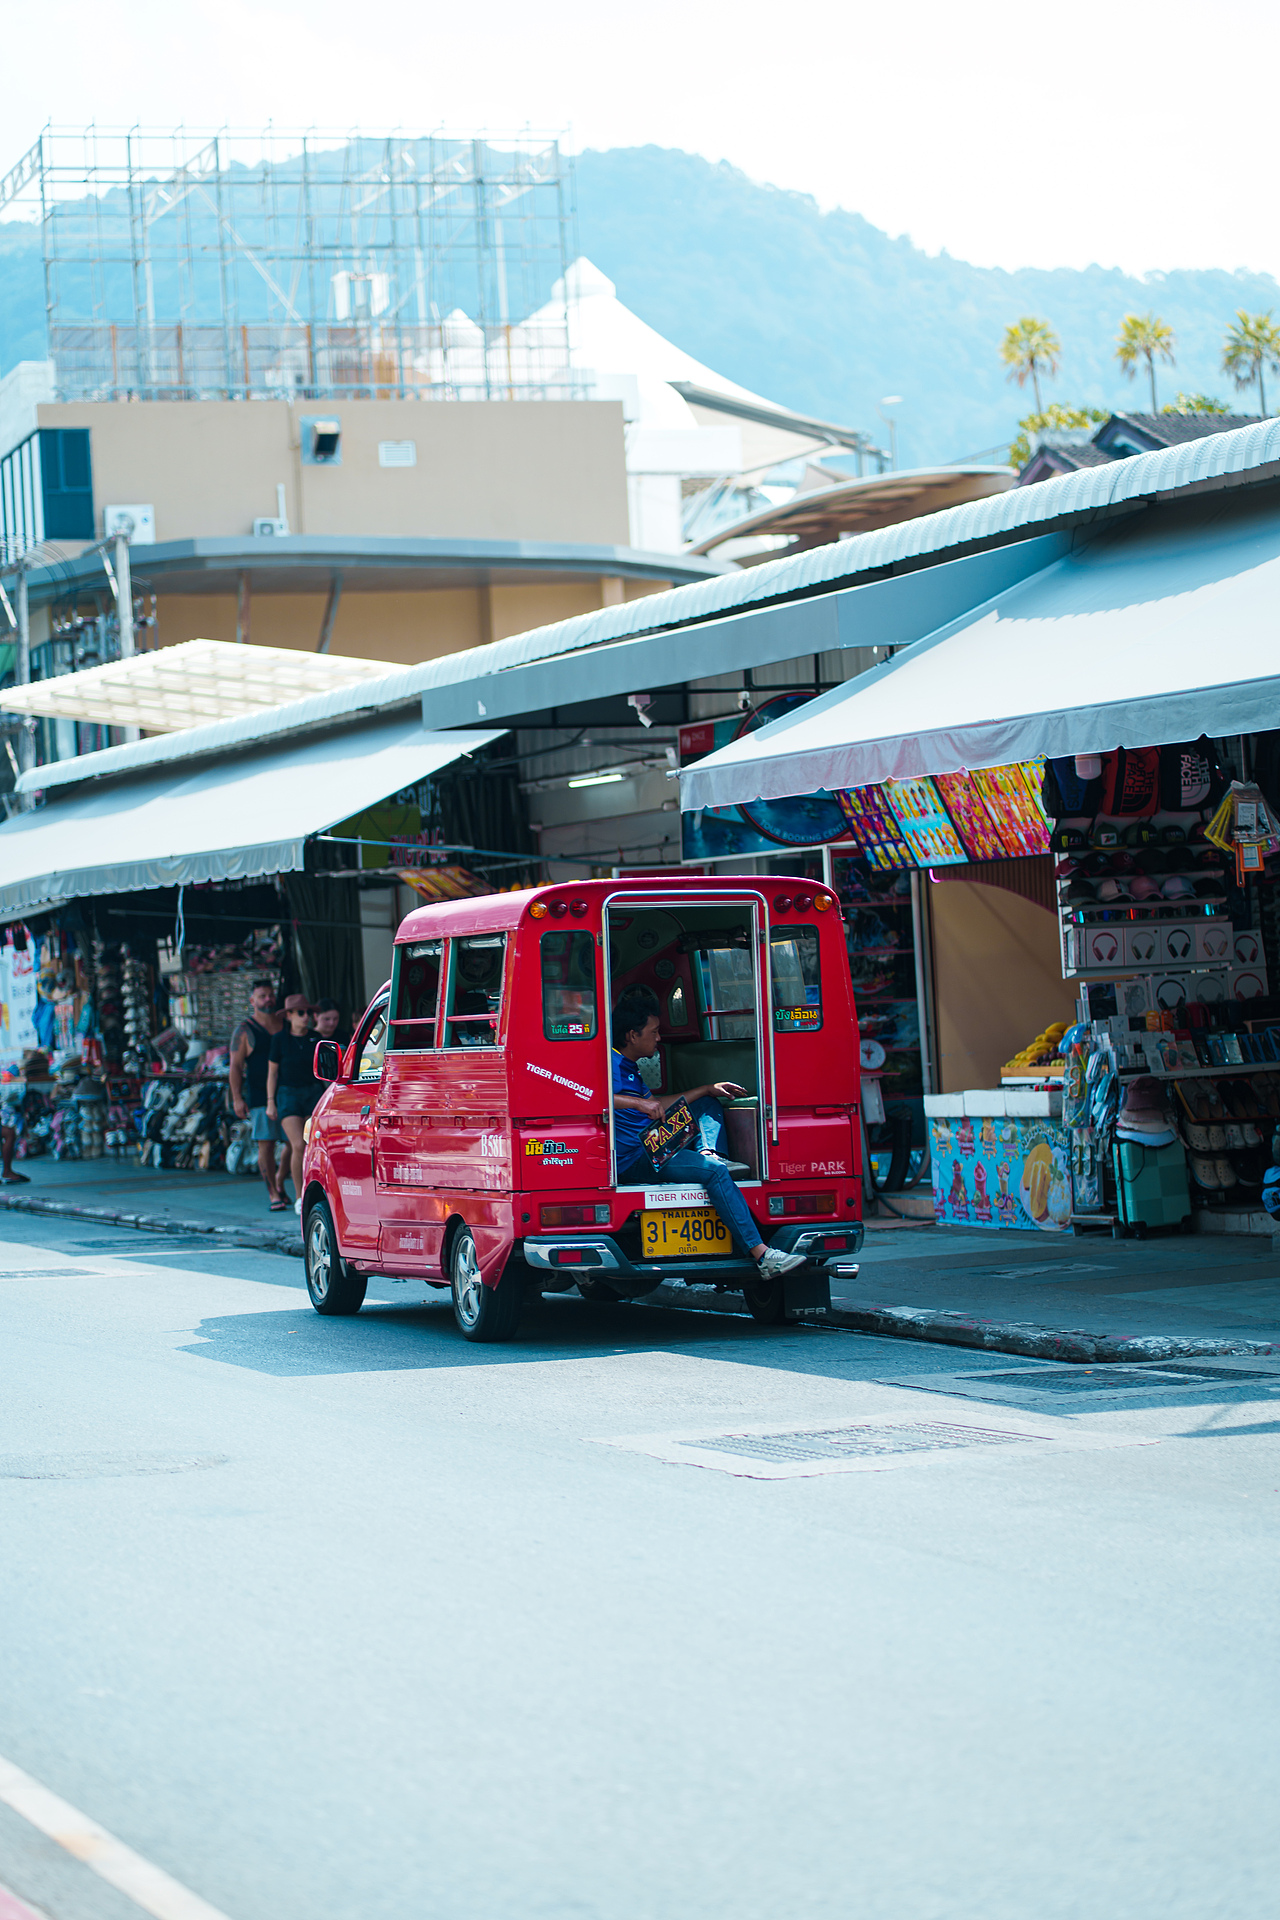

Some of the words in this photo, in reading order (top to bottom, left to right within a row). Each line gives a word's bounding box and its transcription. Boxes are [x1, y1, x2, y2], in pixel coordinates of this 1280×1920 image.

[1125, 762, 1137, 793] FACE
[1134, 760, 1146, 794] ORTH
[1180, 754, 1192, 786] FACE
[1190, 752, 1202, 785] ORTH
[1200, 757, 1211, 784] THE
[1144, 769, 1155, 793] THE
[760, 819, 782, 837] TOUR
[782, 831, 821, 843] BOOKING
[569, 1024, 583, 1034] 25
[526, 1062, 552, 1080] TIGER
[553, 1074, 594, 1097] KINGDOM
[644, 1105, 693, 1153] TAXI
[481, 1134, 504, 1158] B581
[778, 1162, 806, 1175] Tiger
[811, 1161, 846, 1172] PARK
[649, 1193, 677, 1202] TIGER
[661, 1210, 710, 1219] THAILAND
[646, 1219, 727, 1244] 31-4806
[792, 1306, 827, 1316] TFR
